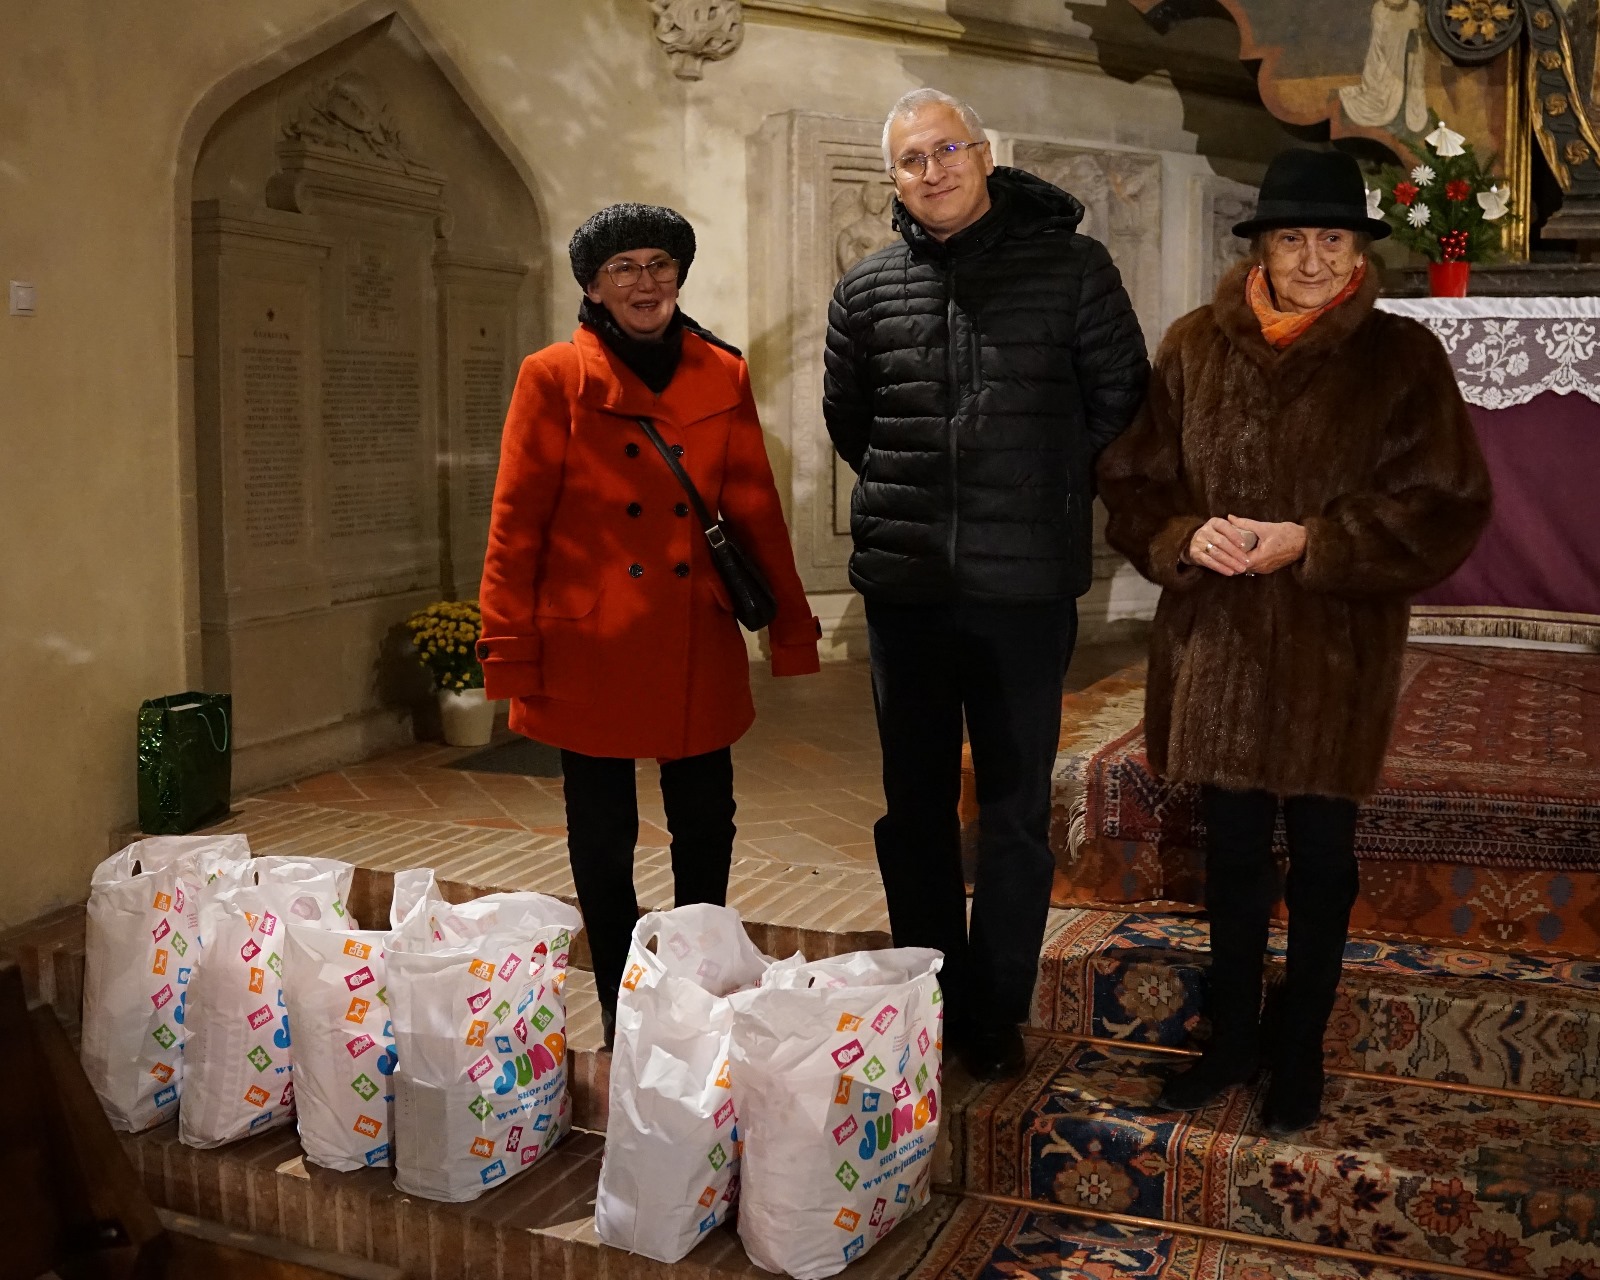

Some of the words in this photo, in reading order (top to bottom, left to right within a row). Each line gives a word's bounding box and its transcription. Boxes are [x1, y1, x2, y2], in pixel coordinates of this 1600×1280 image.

[494, 1033, 566, 1095] JUMB
[518, 1086, 541, 1100] SHOP
[880, 1150, 897, 1167] SHOP
[899, 1135, 924, 1155] ONLINE
